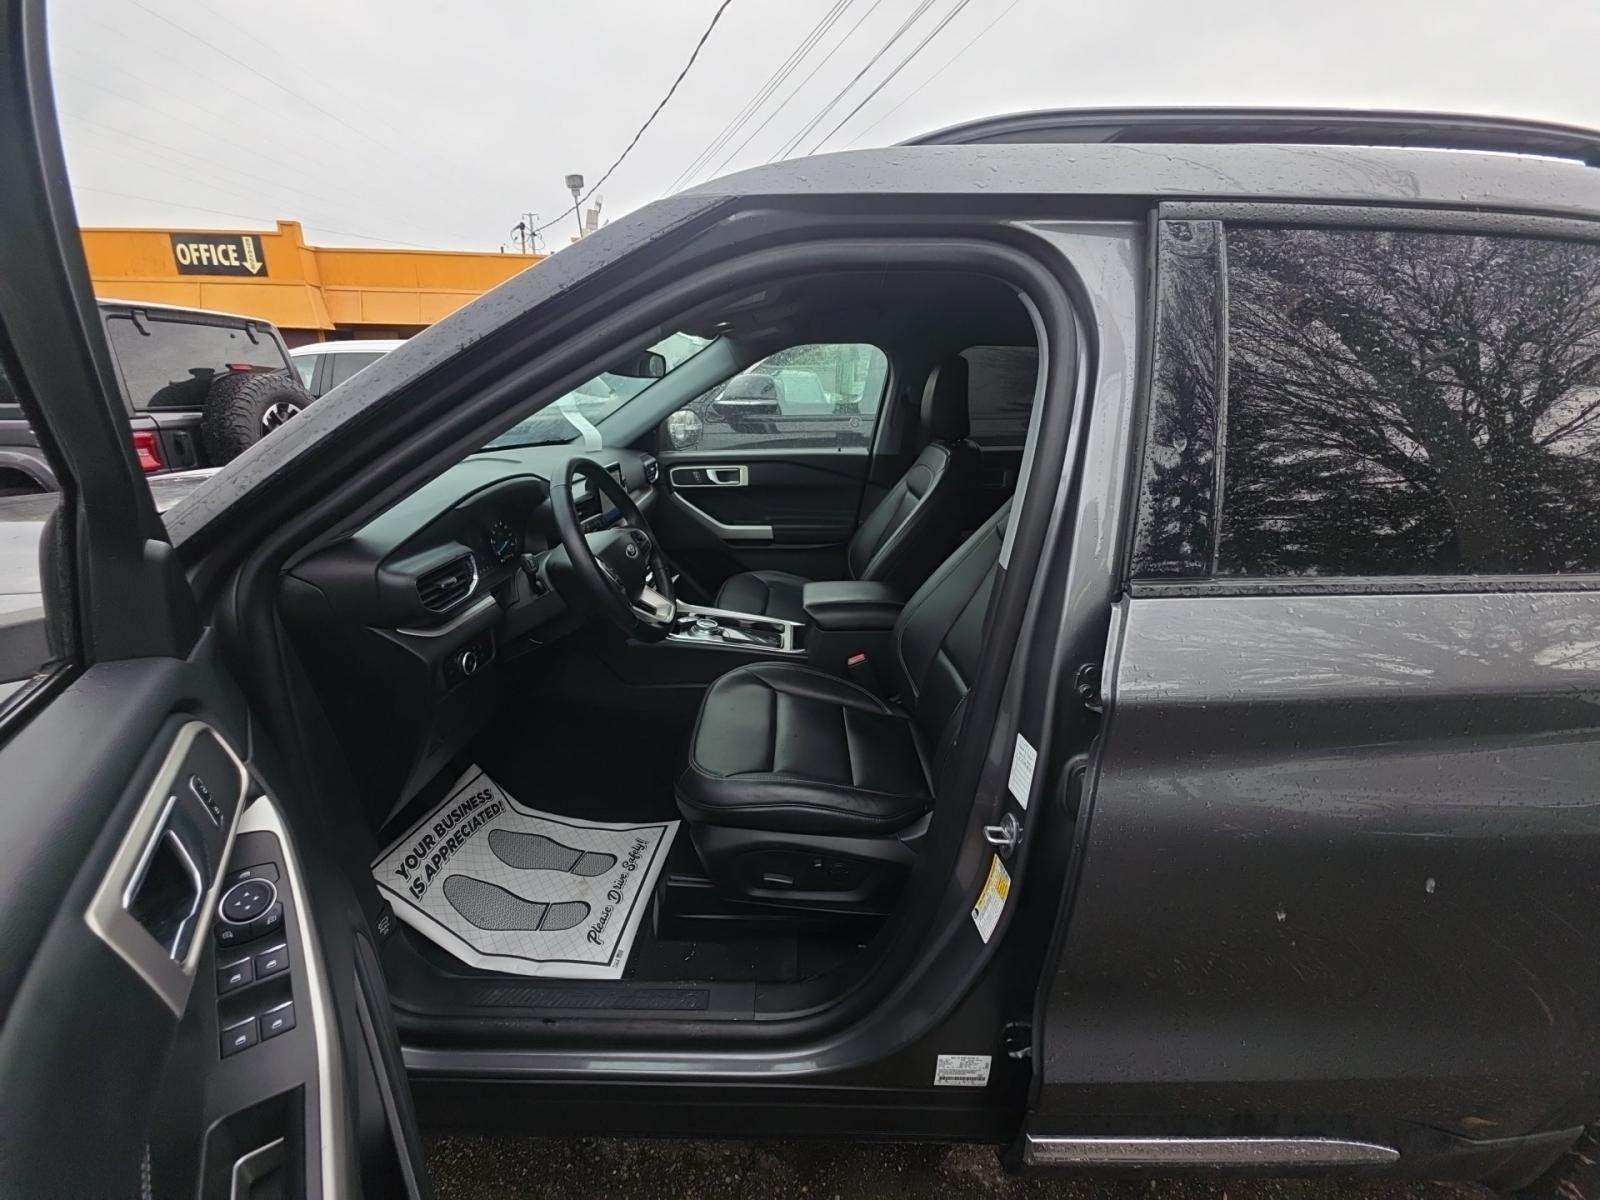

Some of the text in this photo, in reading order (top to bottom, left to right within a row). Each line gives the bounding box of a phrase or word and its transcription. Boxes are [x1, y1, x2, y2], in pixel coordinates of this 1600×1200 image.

[177, 244, 241, 266] OFFICE
[394, 788, 494, 881] YOUR BUSINESS
[409, 799, 506, 900] IS APPRECIATED!
[586, 905, 613, 946] Please
[607, 873, 628, 905] Drive
